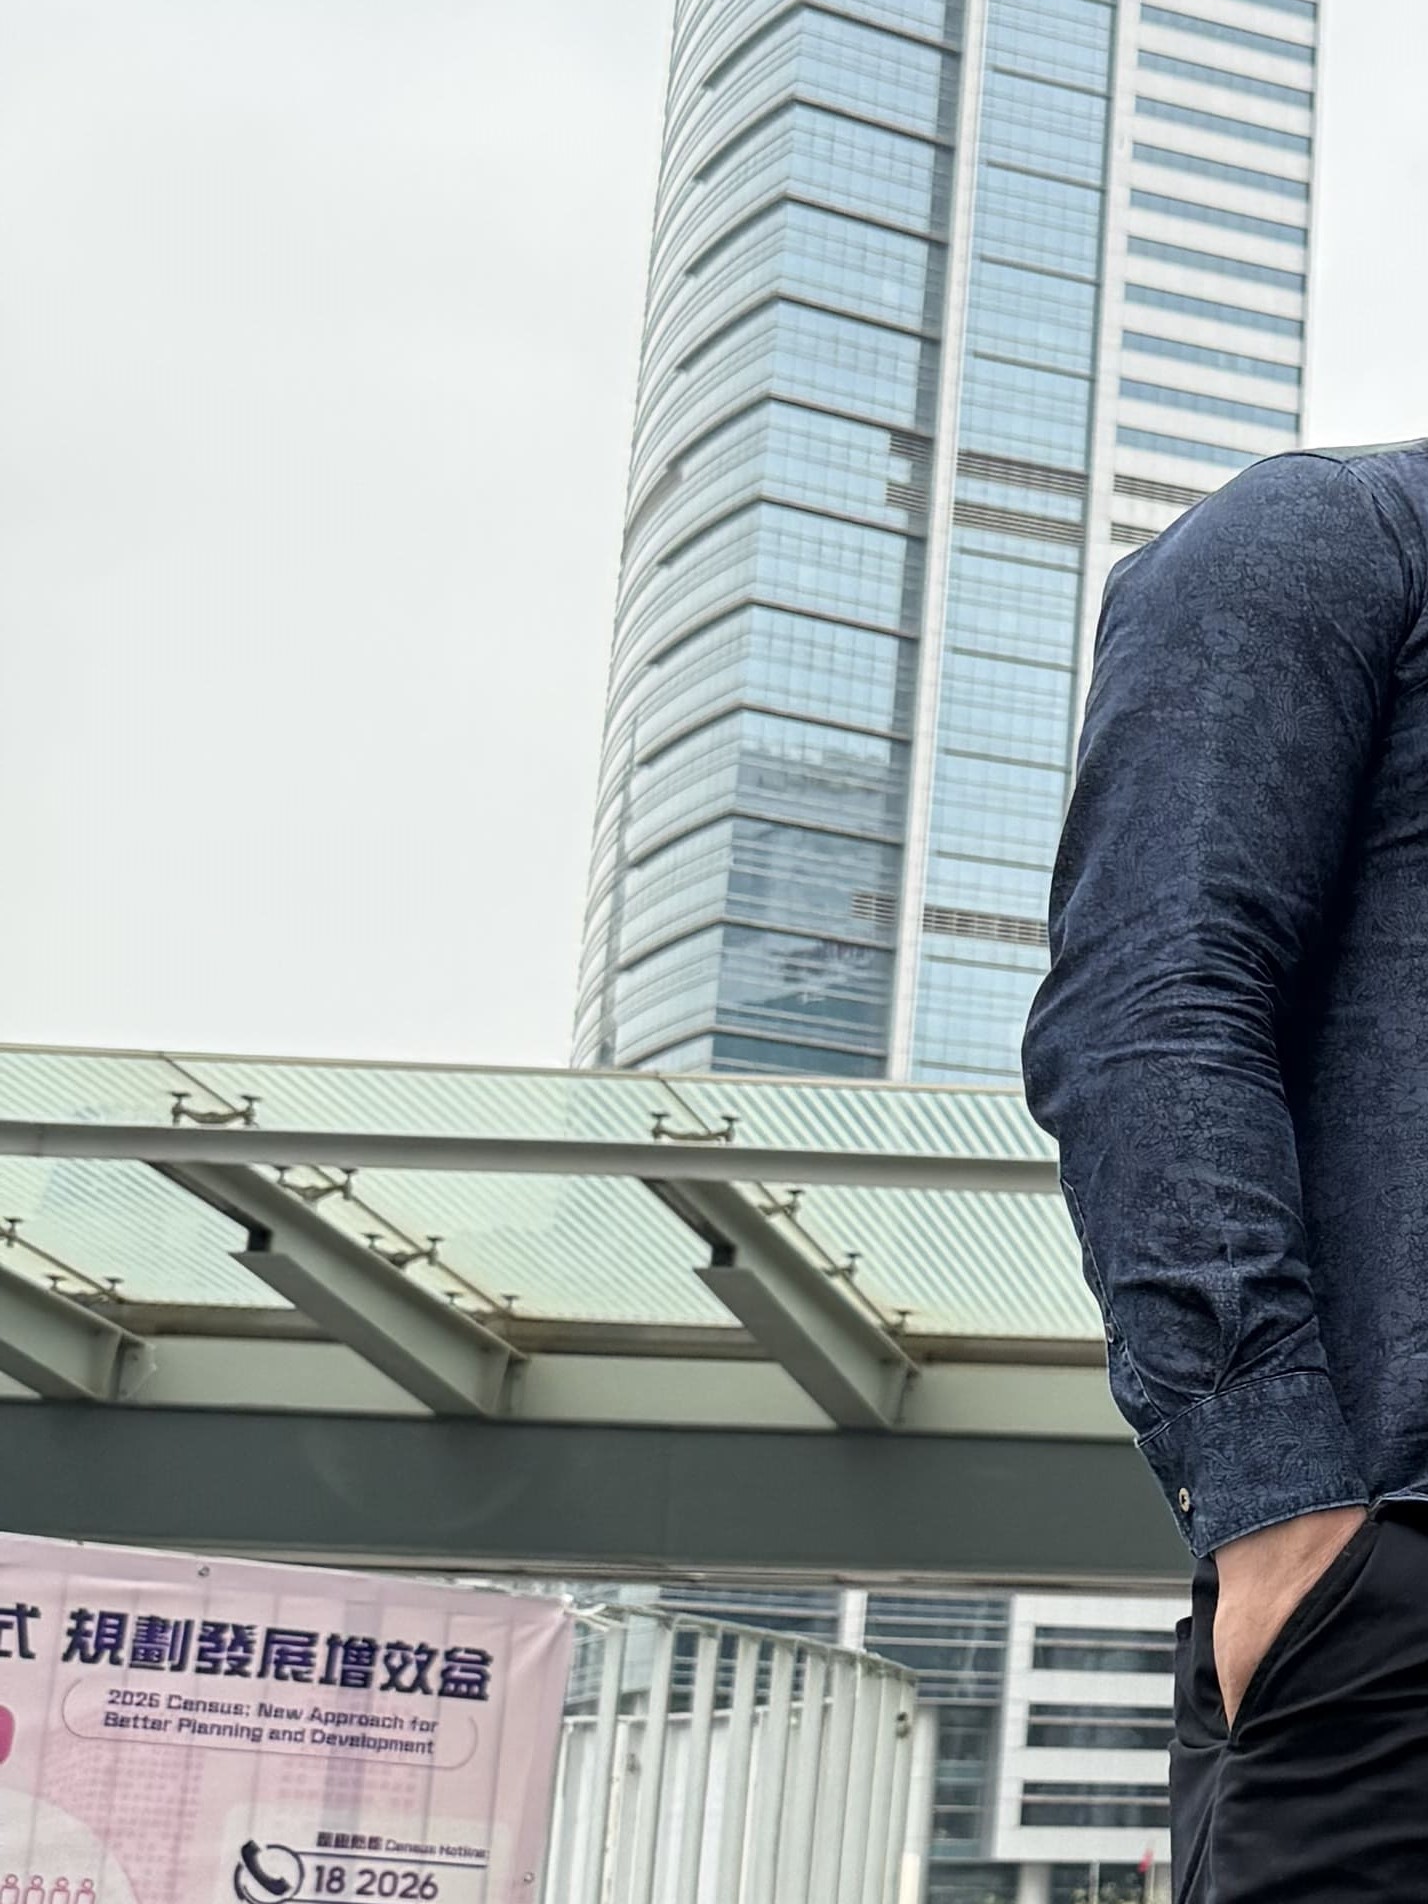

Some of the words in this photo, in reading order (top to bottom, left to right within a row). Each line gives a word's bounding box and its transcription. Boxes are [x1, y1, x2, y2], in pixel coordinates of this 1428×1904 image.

[62, 1608, 493, 1701] 規劃發展增效益
[103, 1711, 172, 1732] Better
[177, 1717, 263, 1742] Planning
[269, 1727, 305, 1743] and
[311, 1729, 435, 1755] Development
[257, 1702, 303, 1721] New
[309, 1706, 403, 1730] Approach
[411, 1715, 439, 1733] for
[314, 1864, 346, 1894] 18
[356, 1868, 439, 1900] 2026
